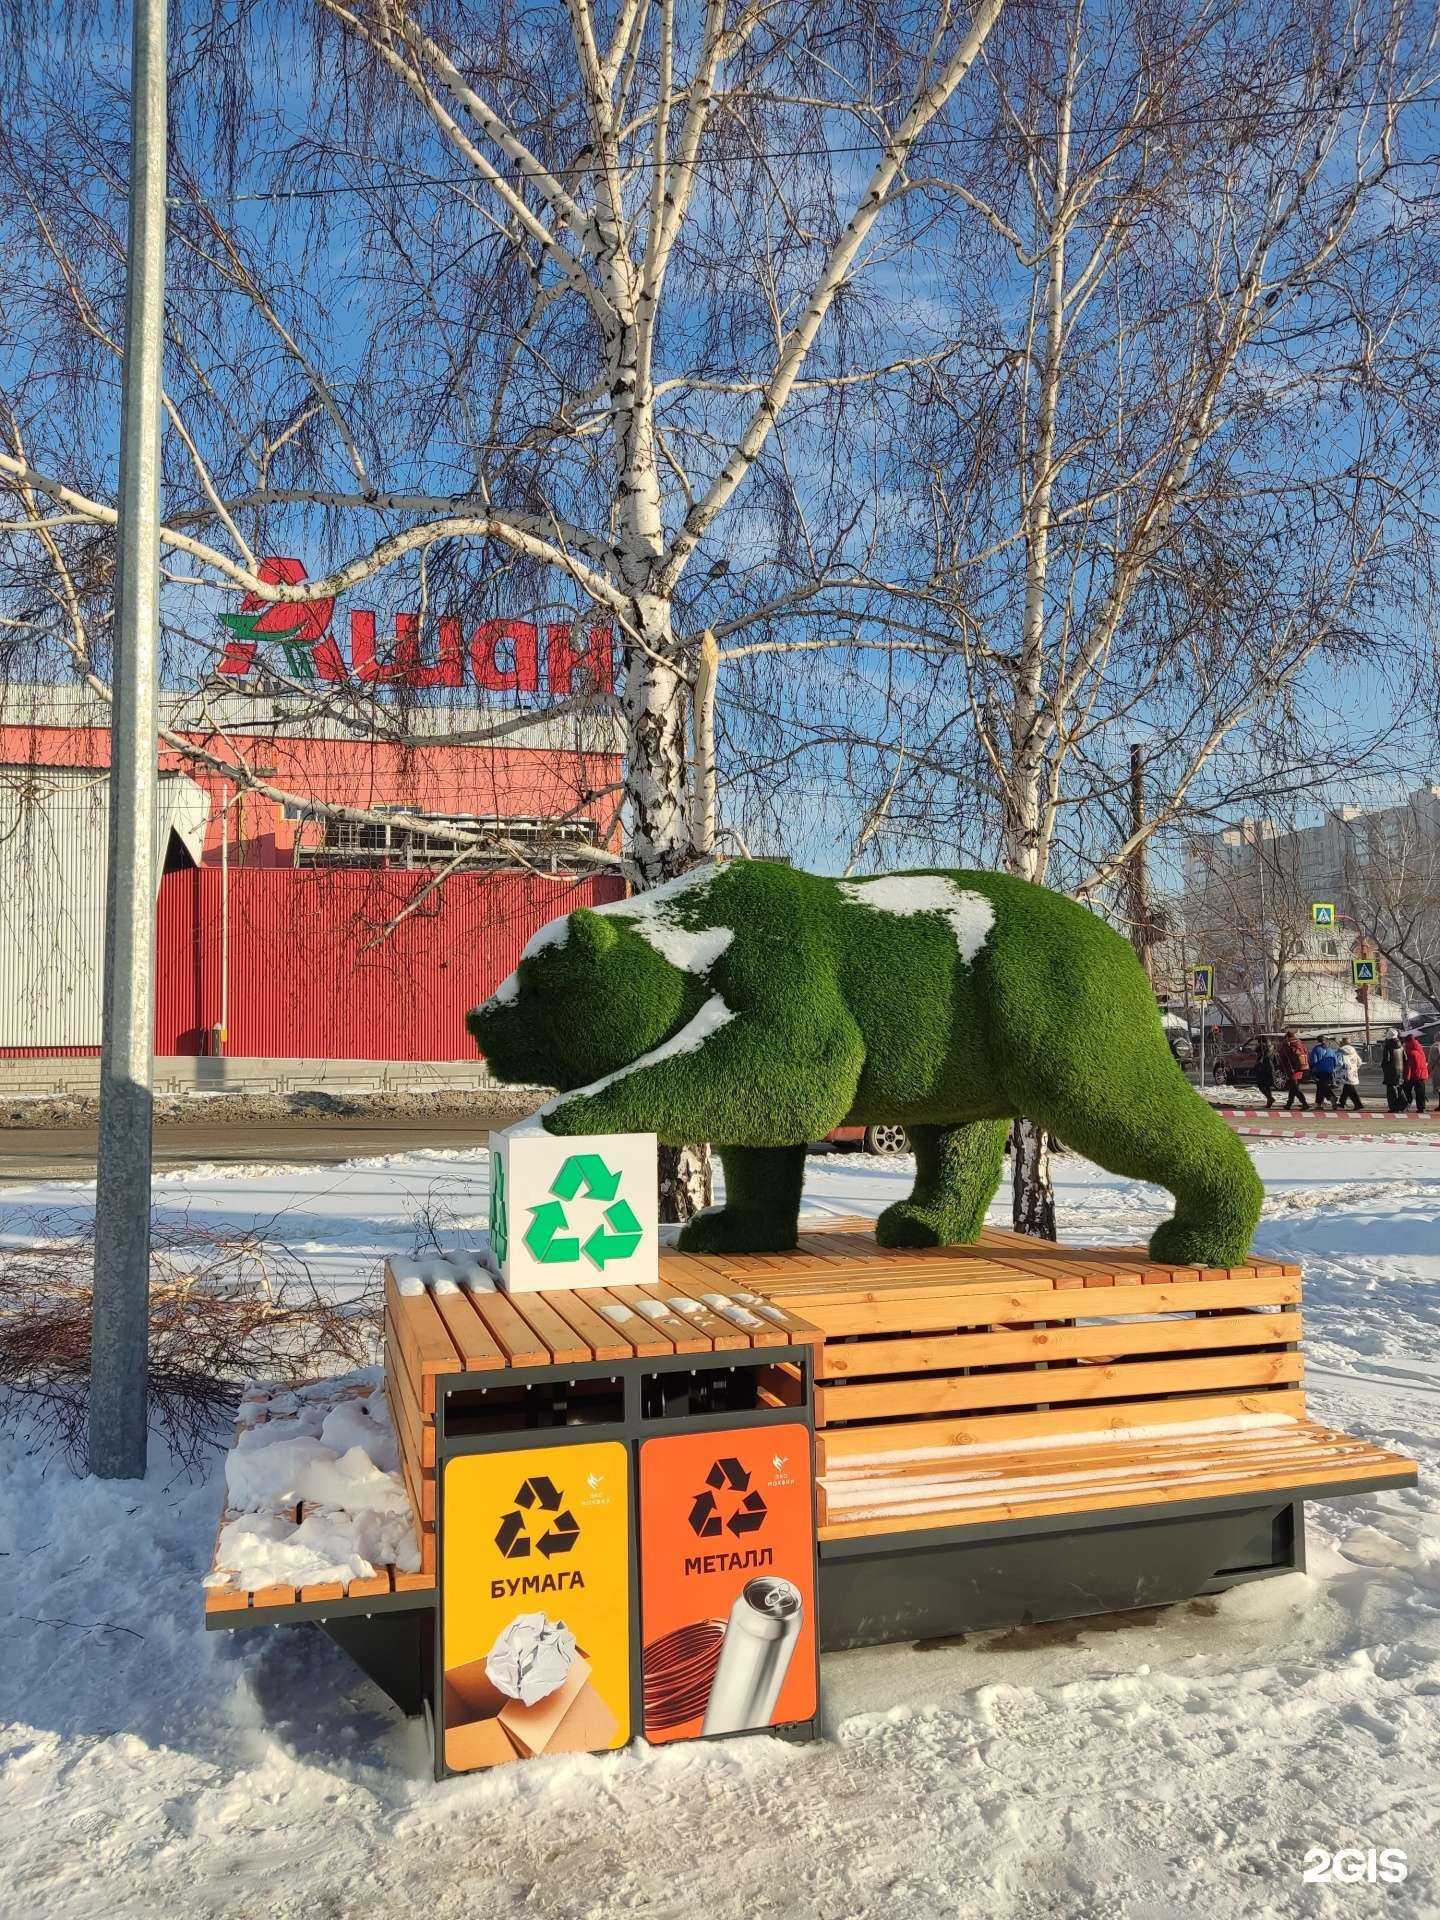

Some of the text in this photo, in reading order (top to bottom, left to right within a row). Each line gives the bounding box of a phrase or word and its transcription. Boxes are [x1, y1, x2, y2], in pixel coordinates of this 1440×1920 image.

[218, 556, 614, 694] Ашан
[684, 1547, 773, 1576] МЕТАЛЛ
[491, 1570, 585, 1599] БУМАГА
